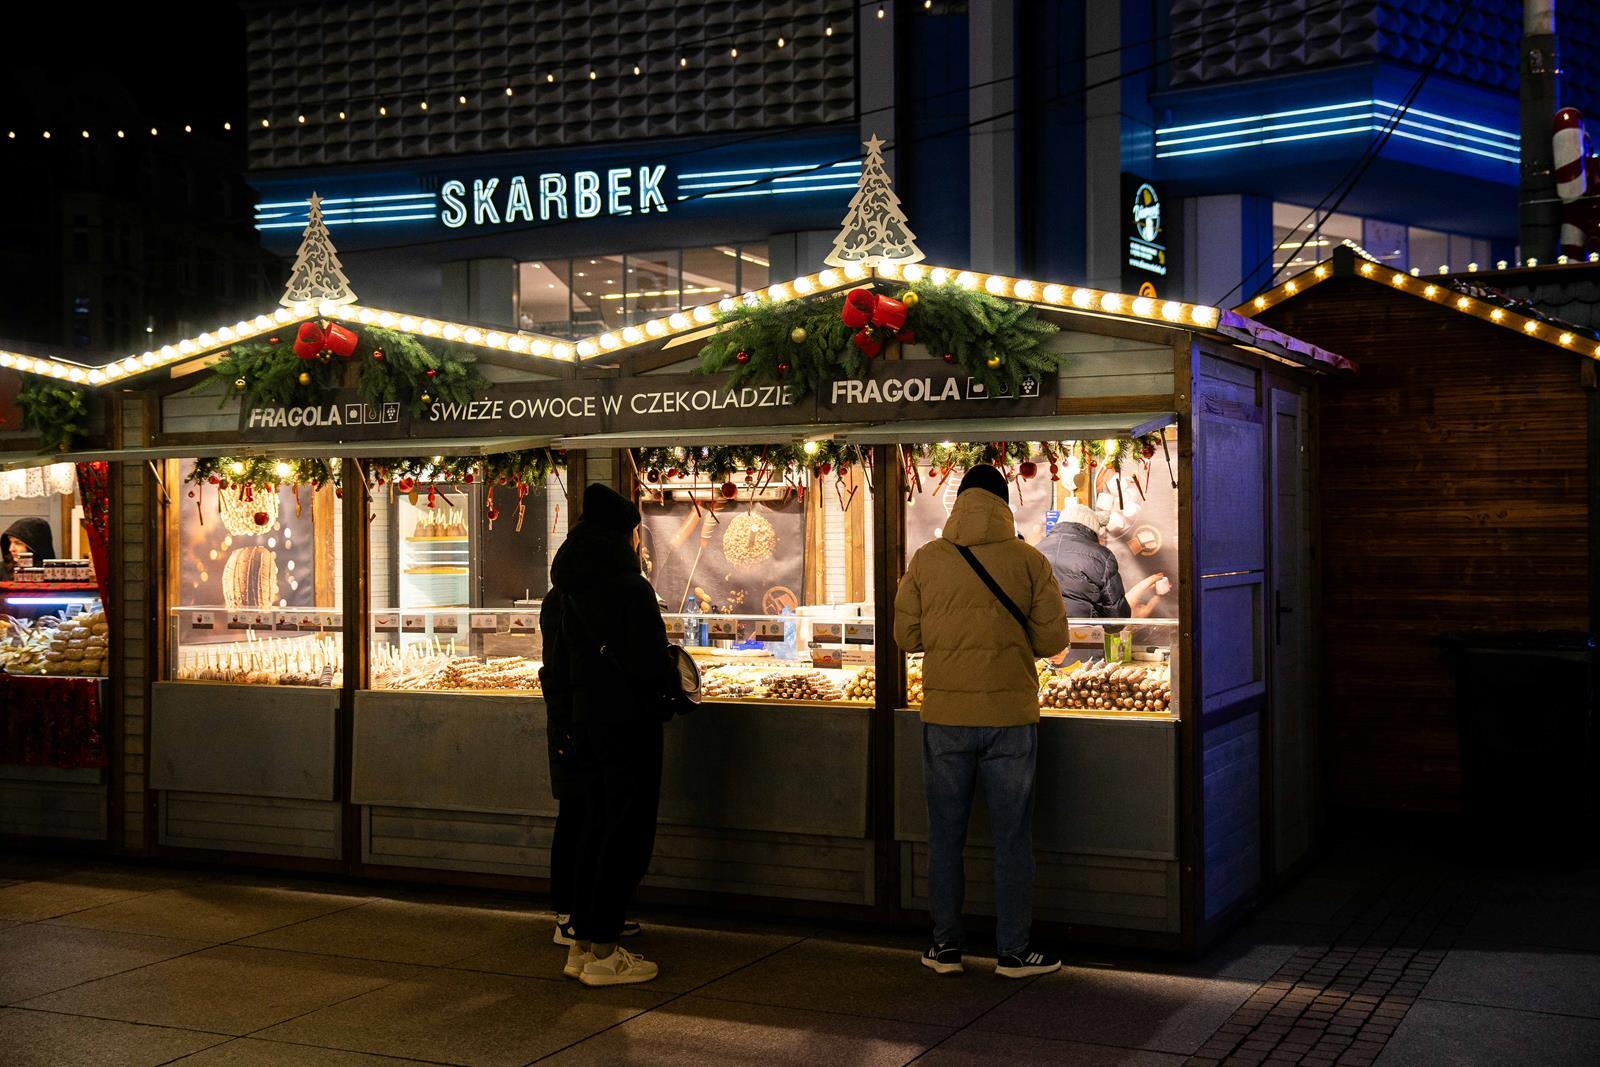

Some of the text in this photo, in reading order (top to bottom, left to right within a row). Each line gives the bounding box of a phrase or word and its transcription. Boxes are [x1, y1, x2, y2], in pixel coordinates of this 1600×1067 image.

[442, 165, 668, 228] SKARBEK
[430, 386, 792, 421] ŚWIEŻE OWOCE W CZEKOLADZIE
[831, 377, 961, 404] FRAGOLA
[249, 405, 342, 427] FRAGOLA
